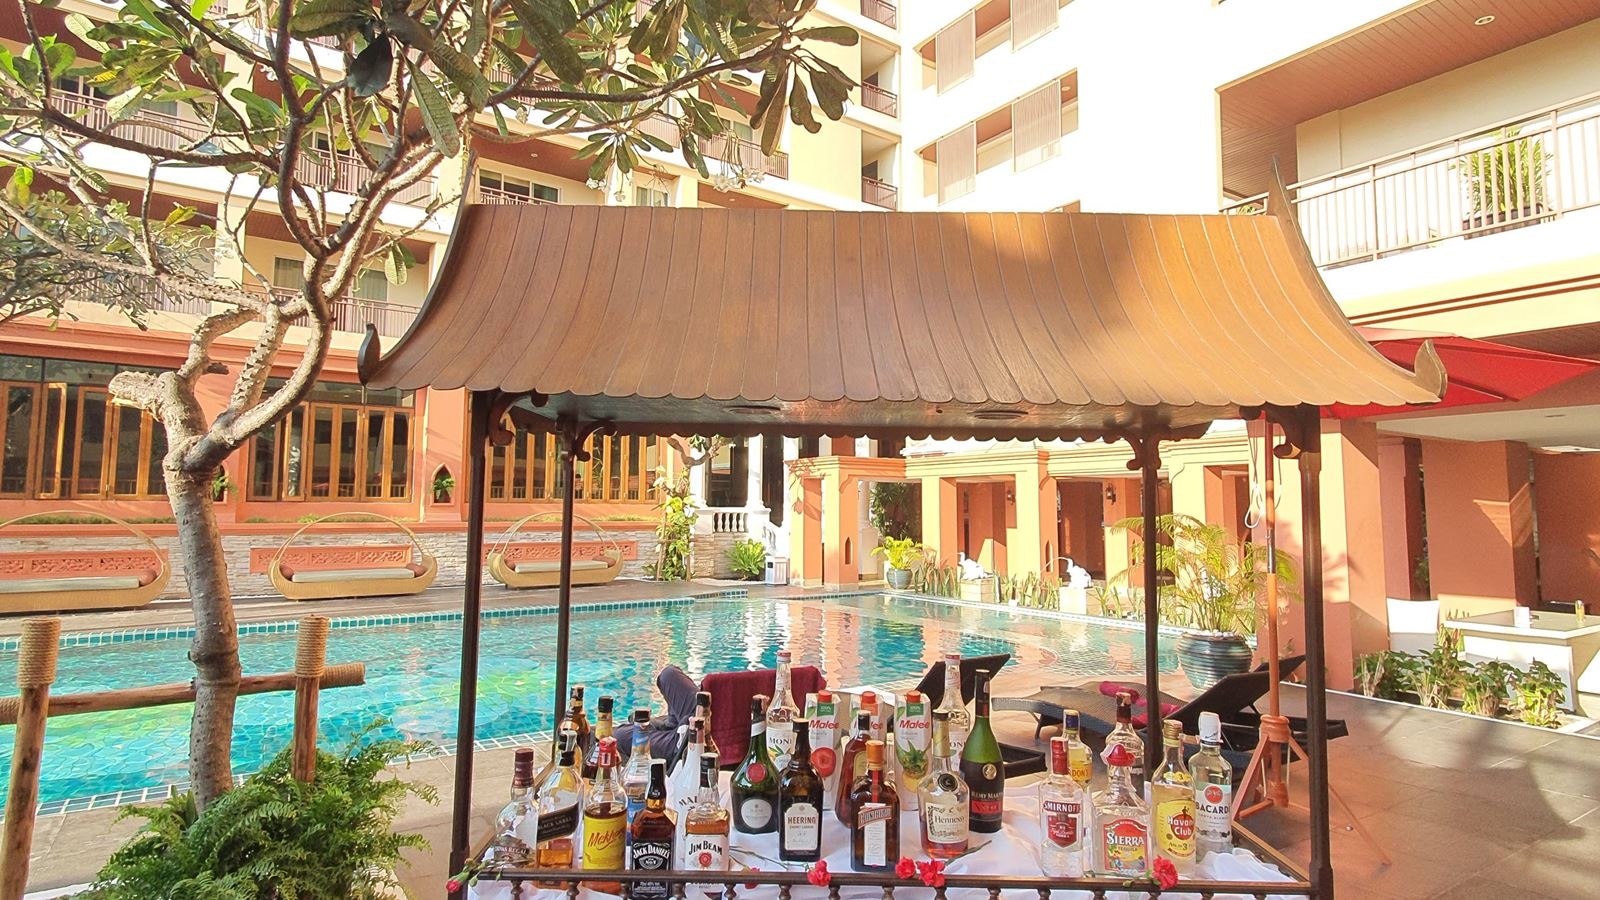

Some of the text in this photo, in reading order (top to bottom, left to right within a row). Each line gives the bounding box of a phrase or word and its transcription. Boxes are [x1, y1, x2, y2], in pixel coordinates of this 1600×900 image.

[810, 719, 840, 730] Malee
[899, 719, 930, 729] Malee
[769, 737, 792, 745] MONI
[1044, 801, 1080, 813] SMIRNOFF
[787, 816, 817, 825] HEERING
[1167, 816, 1194, 825] Havan
[1174, 826, 1192, 836] Club
[1106, 831, 1145, 845] SIERRA
[633, 846, 648, 859] JACK
[689, 840, 723, 856] JIM BEAM
